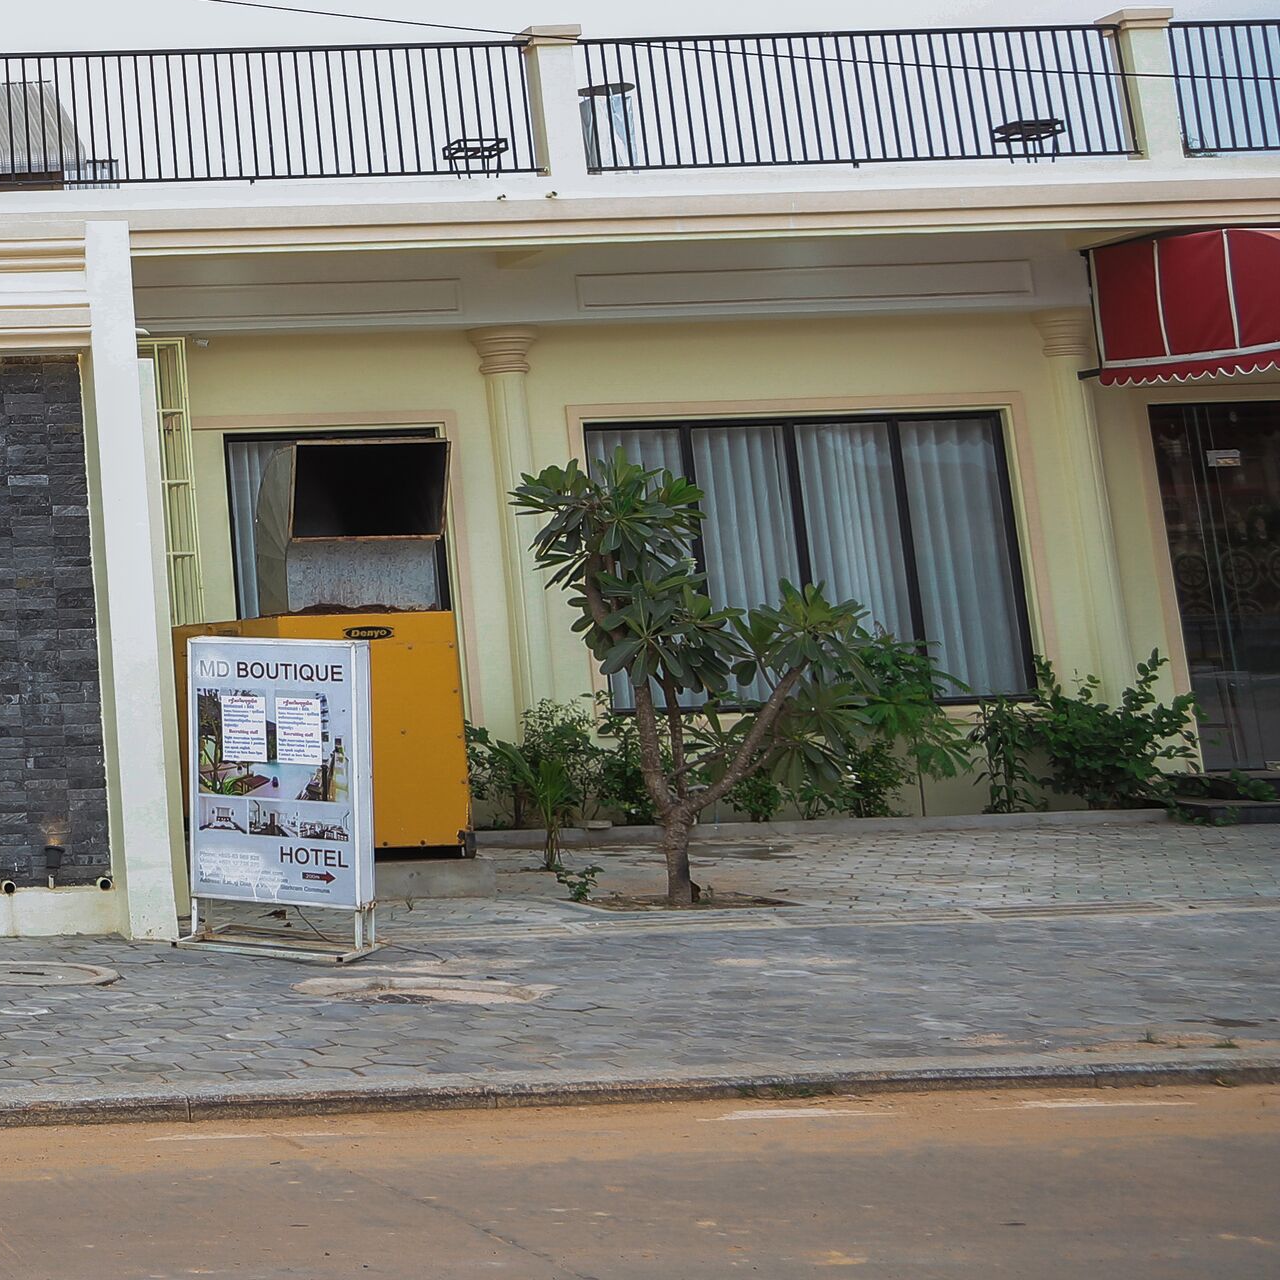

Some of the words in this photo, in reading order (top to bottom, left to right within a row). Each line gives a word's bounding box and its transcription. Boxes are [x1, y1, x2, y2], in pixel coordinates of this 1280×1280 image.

[351, 629, 387, 639] Denyo
[199, 660, 230, 678] MD
[236, 661, 344, 682] BOUTIQUE
[280, 846, 349, 869] HOTEL
